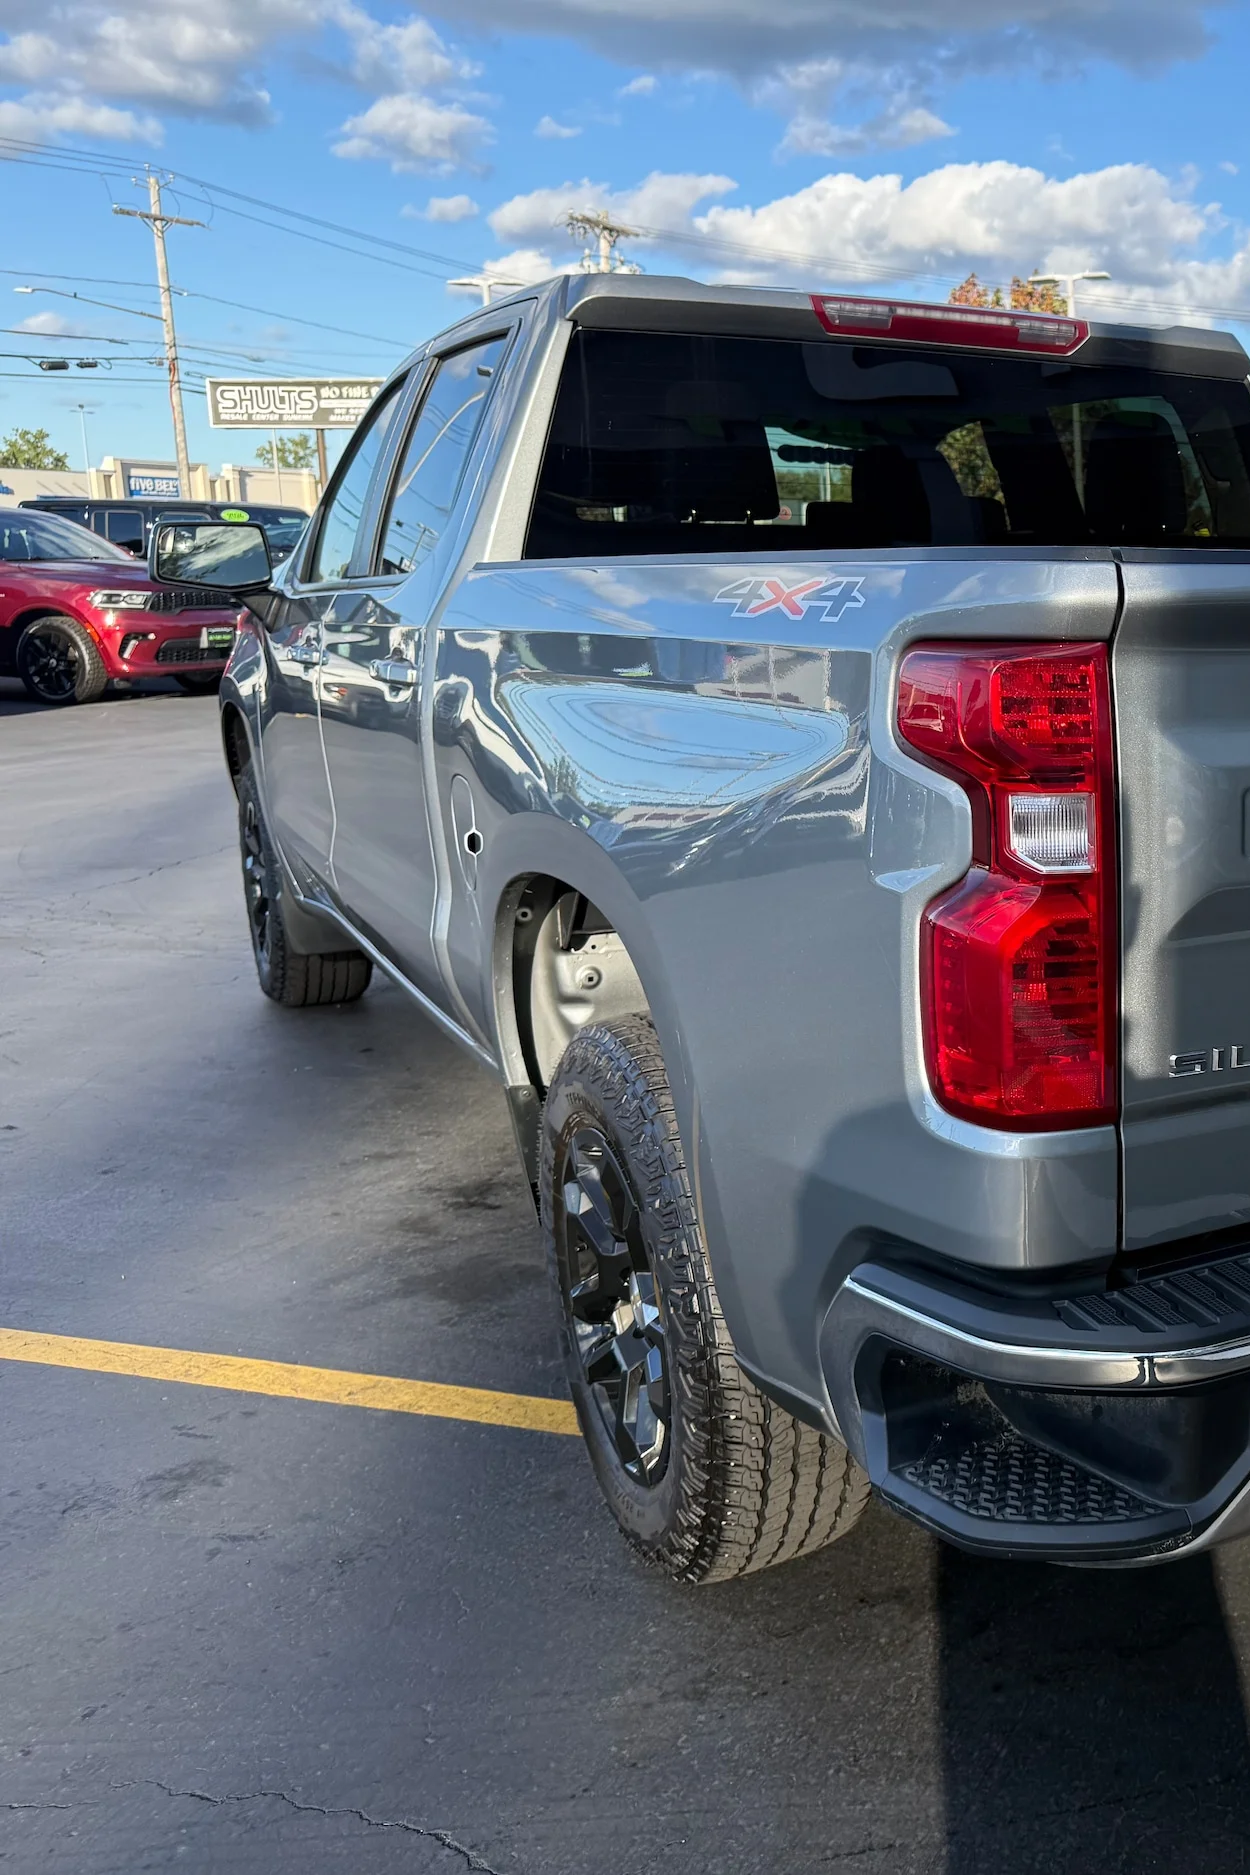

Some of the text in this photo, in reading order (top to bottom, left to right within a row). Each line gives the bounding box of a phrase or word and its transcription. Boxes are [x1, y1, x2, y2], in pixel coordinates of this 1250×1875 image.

[216, 386, 318, 415] SHULTS
[320, 386, 340, 399] NO
[341, 386, 370, 399] FINE
